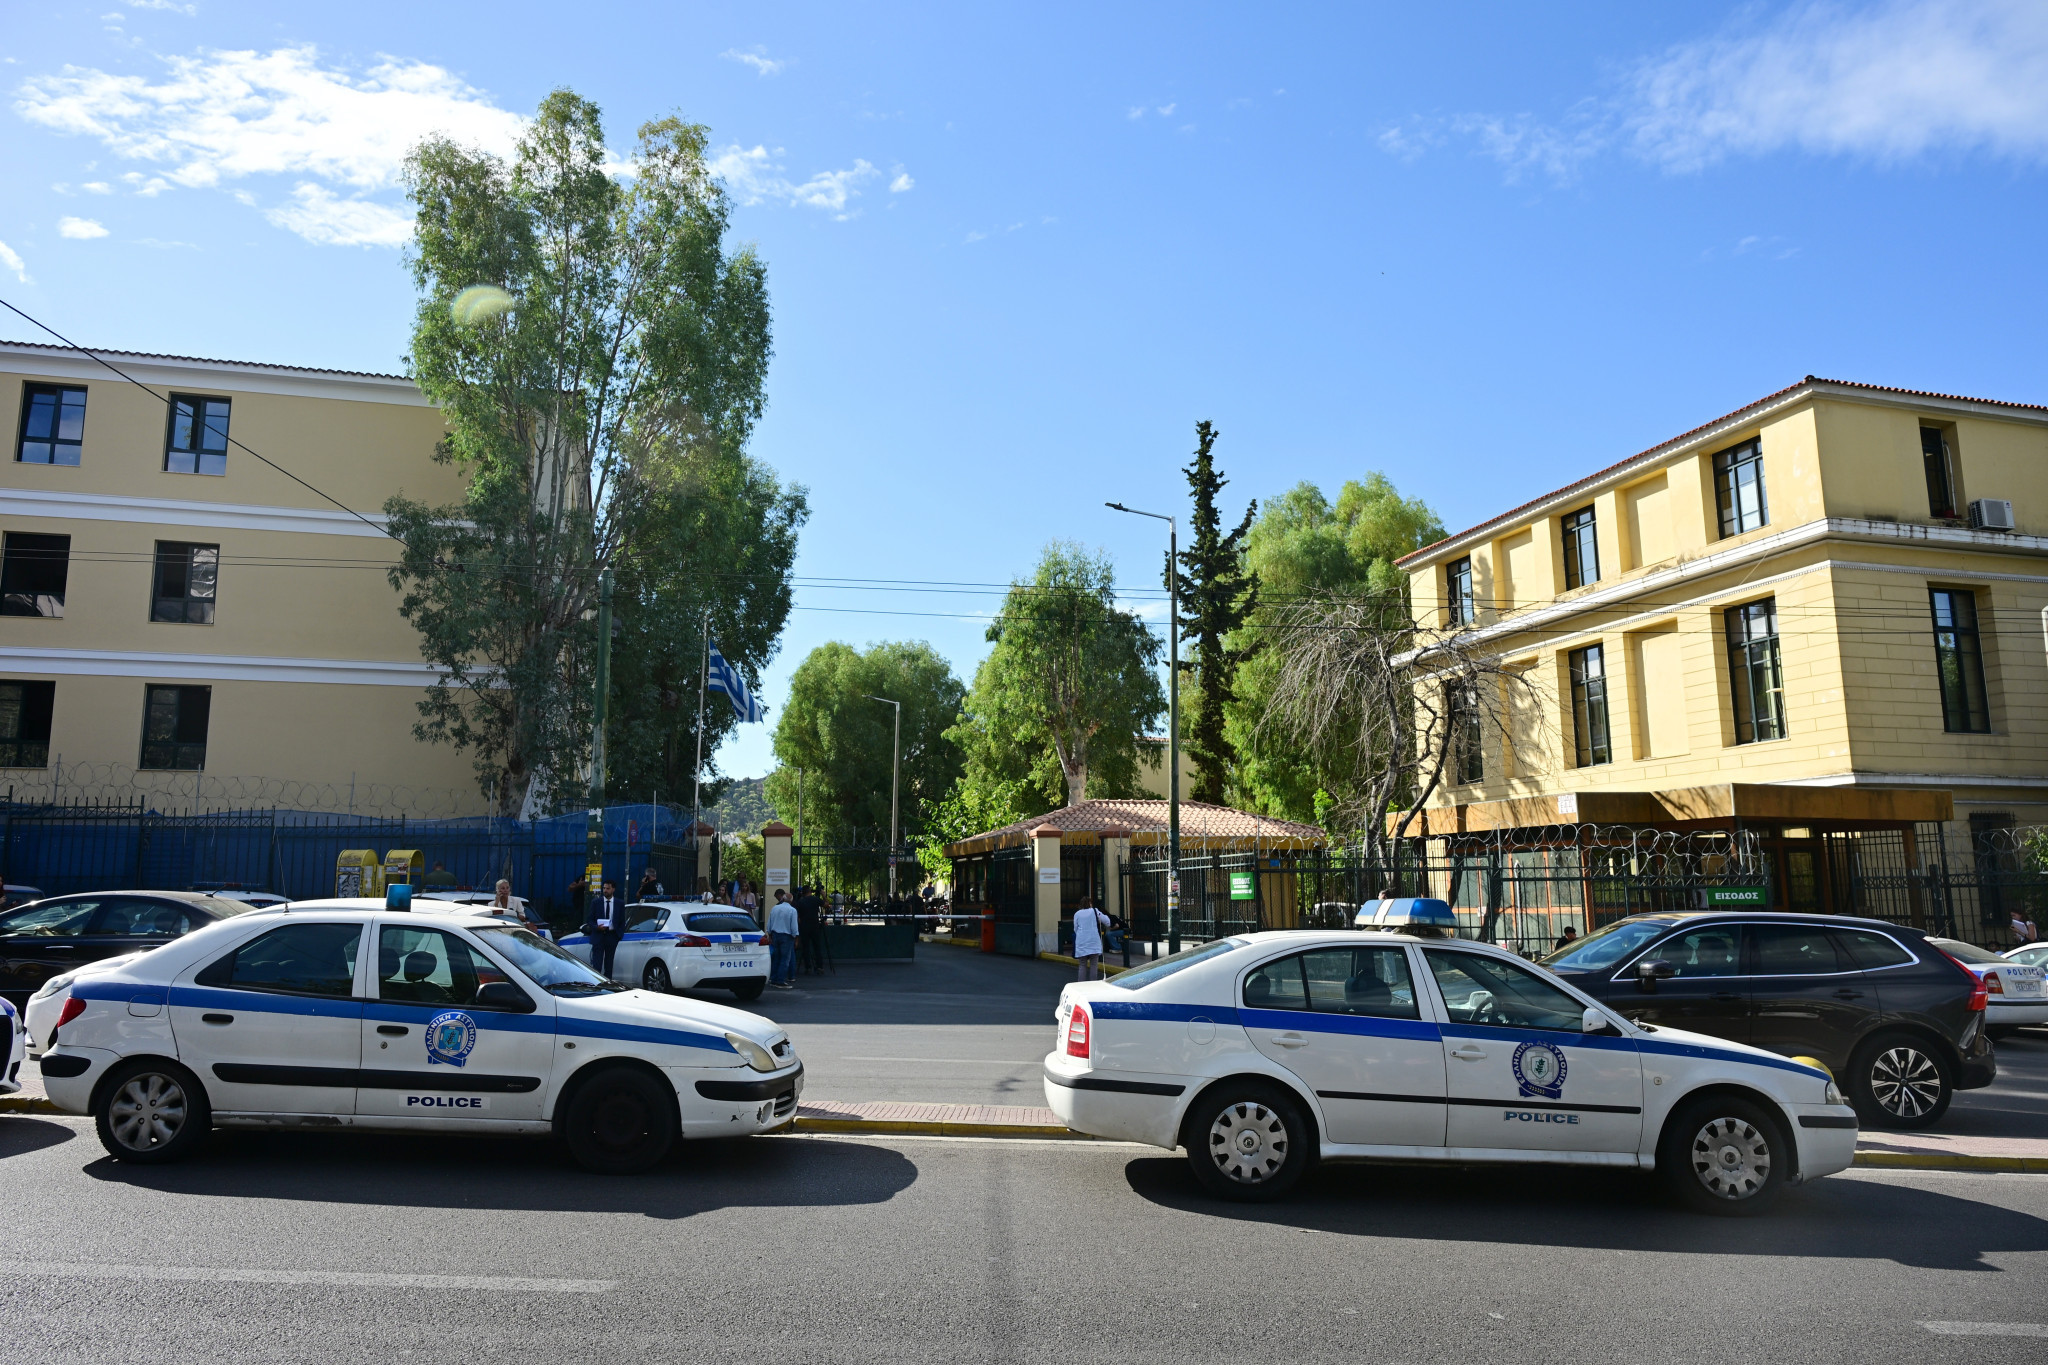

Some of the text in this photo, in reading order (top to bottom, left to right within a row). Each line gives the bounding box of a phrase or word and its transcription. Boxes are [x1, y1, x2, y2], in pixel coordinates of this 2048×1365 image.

[1714, 892, 1759, 900] ΕΙΣΟΔΟΣ
[720, 960, 754, 968] POLICE
[426, 1014, 475, 1055] ΕΛΛΗΝΙΚΗ ΑΣΤΥΝΟΜΙΑ
[1513, 1040, 1567, 1086] ΕΛΛΗΝΙΚΗ ΑΣΤΥΝΟΜΙΑ
[407, 1096, 482, 1108] POLICE
[1505, 1111, 1579, 1125] POLICE
